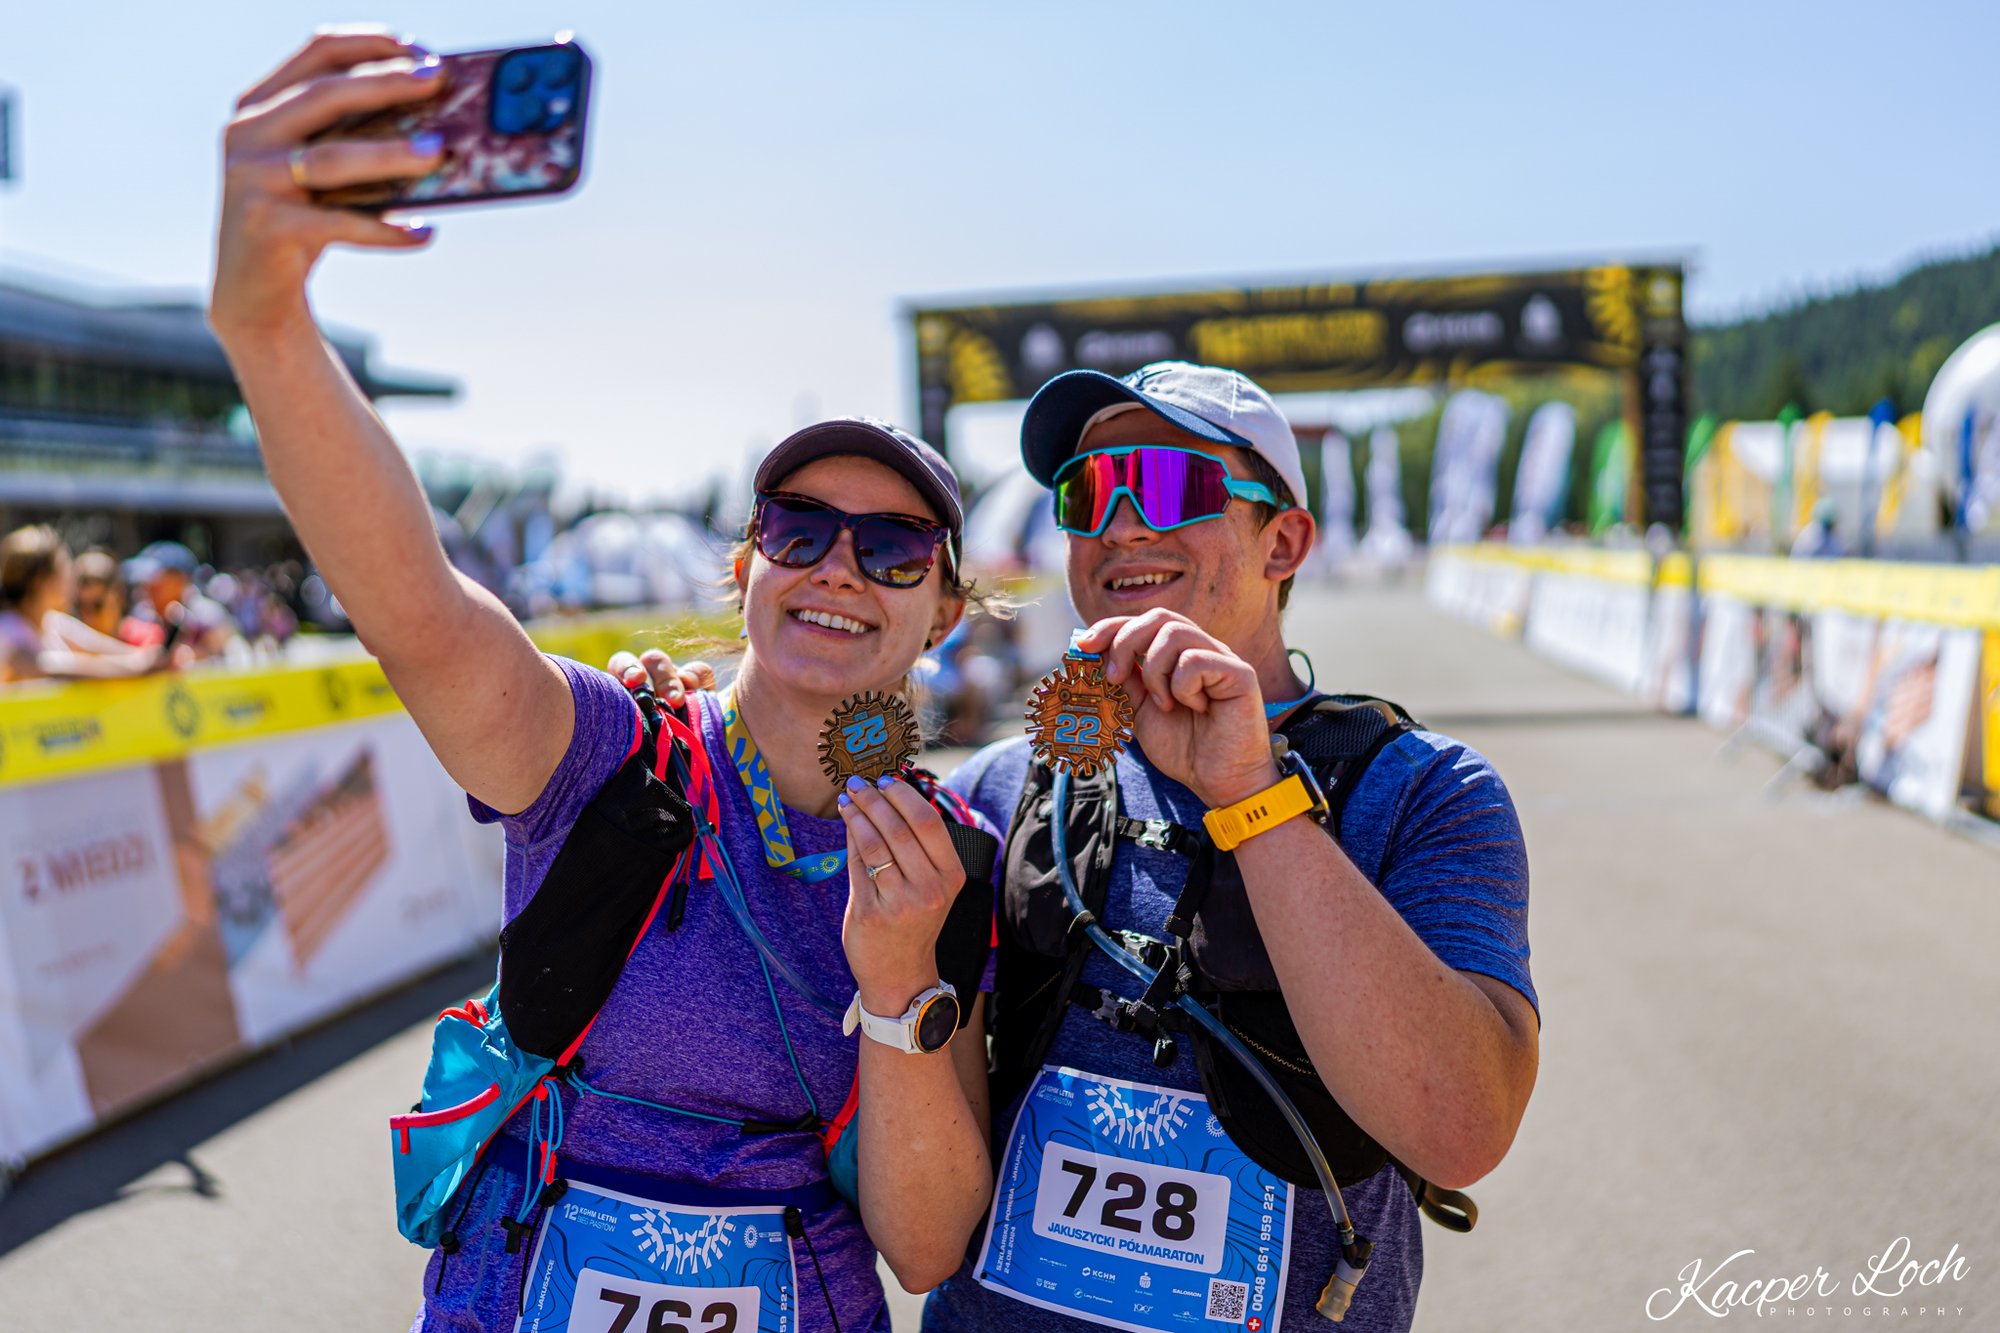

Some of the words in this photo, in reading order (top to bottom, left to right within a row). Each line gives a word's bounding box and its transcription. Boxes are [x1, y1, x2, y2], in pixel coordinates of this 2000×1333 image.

[842, 714, 888, 753] 22
[1054, 713, 1101, 746] 22
[563, 1203, 579, 1221] 12
[597, 1212, 618, 1224] LETNI
[1061, 1159, 1198, 1241] 728
[1263, 1185, 1276, 1211] 221
[1047, 1222, 1115, 1248] JAKUSZYCKI
[1118, 1238, 1204, 1264] PÓŁMARATON
[1260, 1215, 1272, 1241] 959
[1092, 1269, 1116, 1281] KGHM
[1257, 1247, 1270, 1272] 661
[538, 1259, 555, 1310] JAKUSZYCE
[1252, 1276, 1266, 1311] 0048
